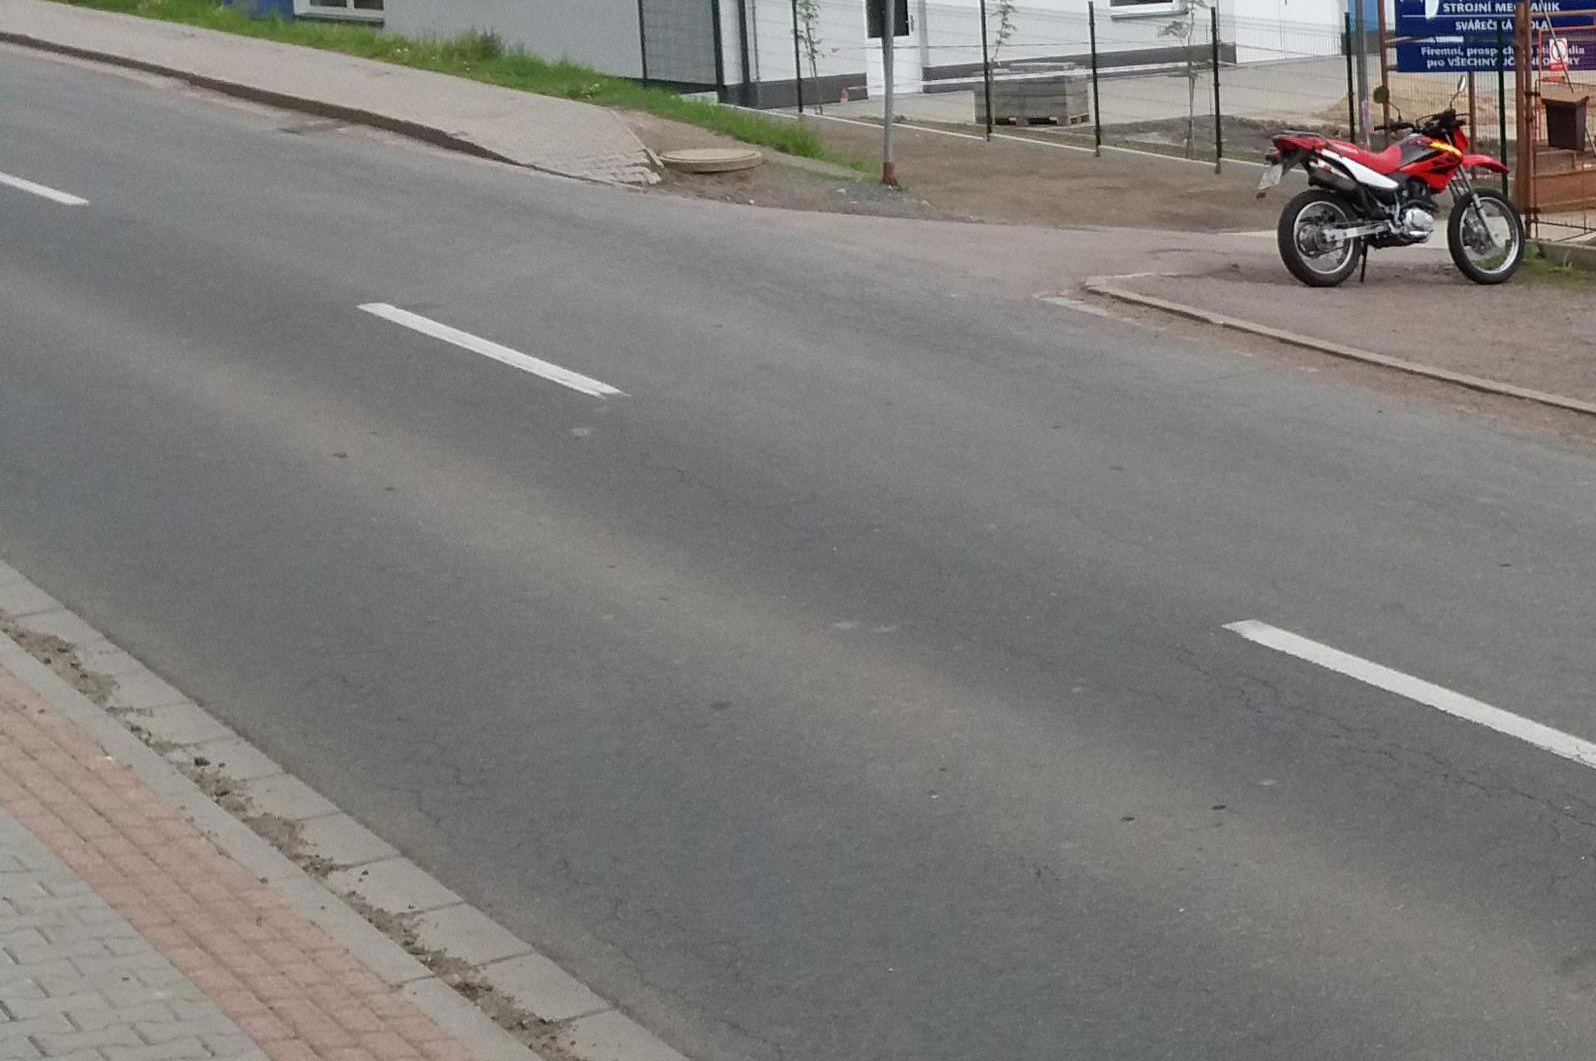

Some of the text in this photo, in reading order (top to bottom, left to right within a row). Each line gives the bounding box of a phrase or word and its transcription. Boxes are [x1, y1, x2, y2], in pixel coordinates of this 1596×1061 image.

[1442, 1, 1492, 12] STROJNÍ
[1426, 59, 1445, 69] pro
[1447, 56, 1498, 66] VŠECHNY
